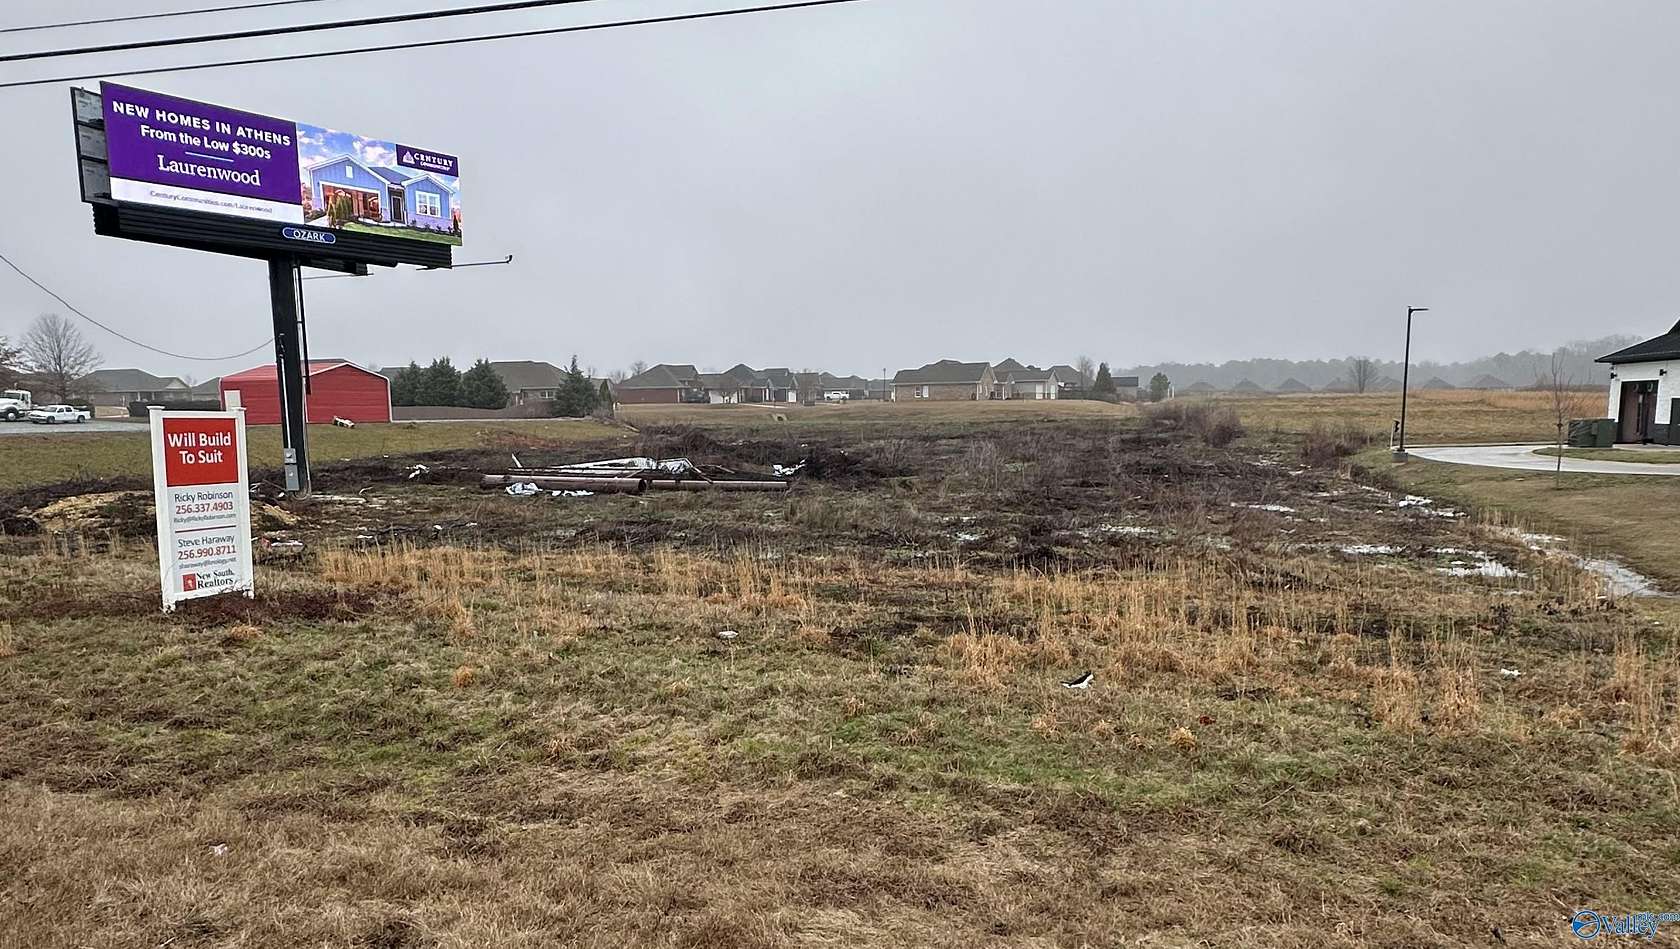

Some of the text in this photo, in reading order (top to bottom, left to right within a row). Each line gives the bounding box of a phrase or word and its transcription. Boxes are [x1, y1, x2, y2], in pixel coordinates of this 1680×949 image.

[112, 100, 291, 146] NEW HOMES IN ATHENS
[140, 124, 272, 160] From the Low $300s
[413, 152, 453, 167] CENTURY
[157, 154, 261, 186] Laurenwood
[293, 230, 326, 242] OZARK
[168, 431, 232, 448] Will Build
[179, 448, 224, 465] To Suit
[174, 491, 234, 503] Ricky Robinson
[175, 501, 234, 515] 256.337.4903
[177, 535, 235, 548] Steve Haraway
[177, 545, 237, 561] 256.990.8711
[196, 572, 211, 580] New
